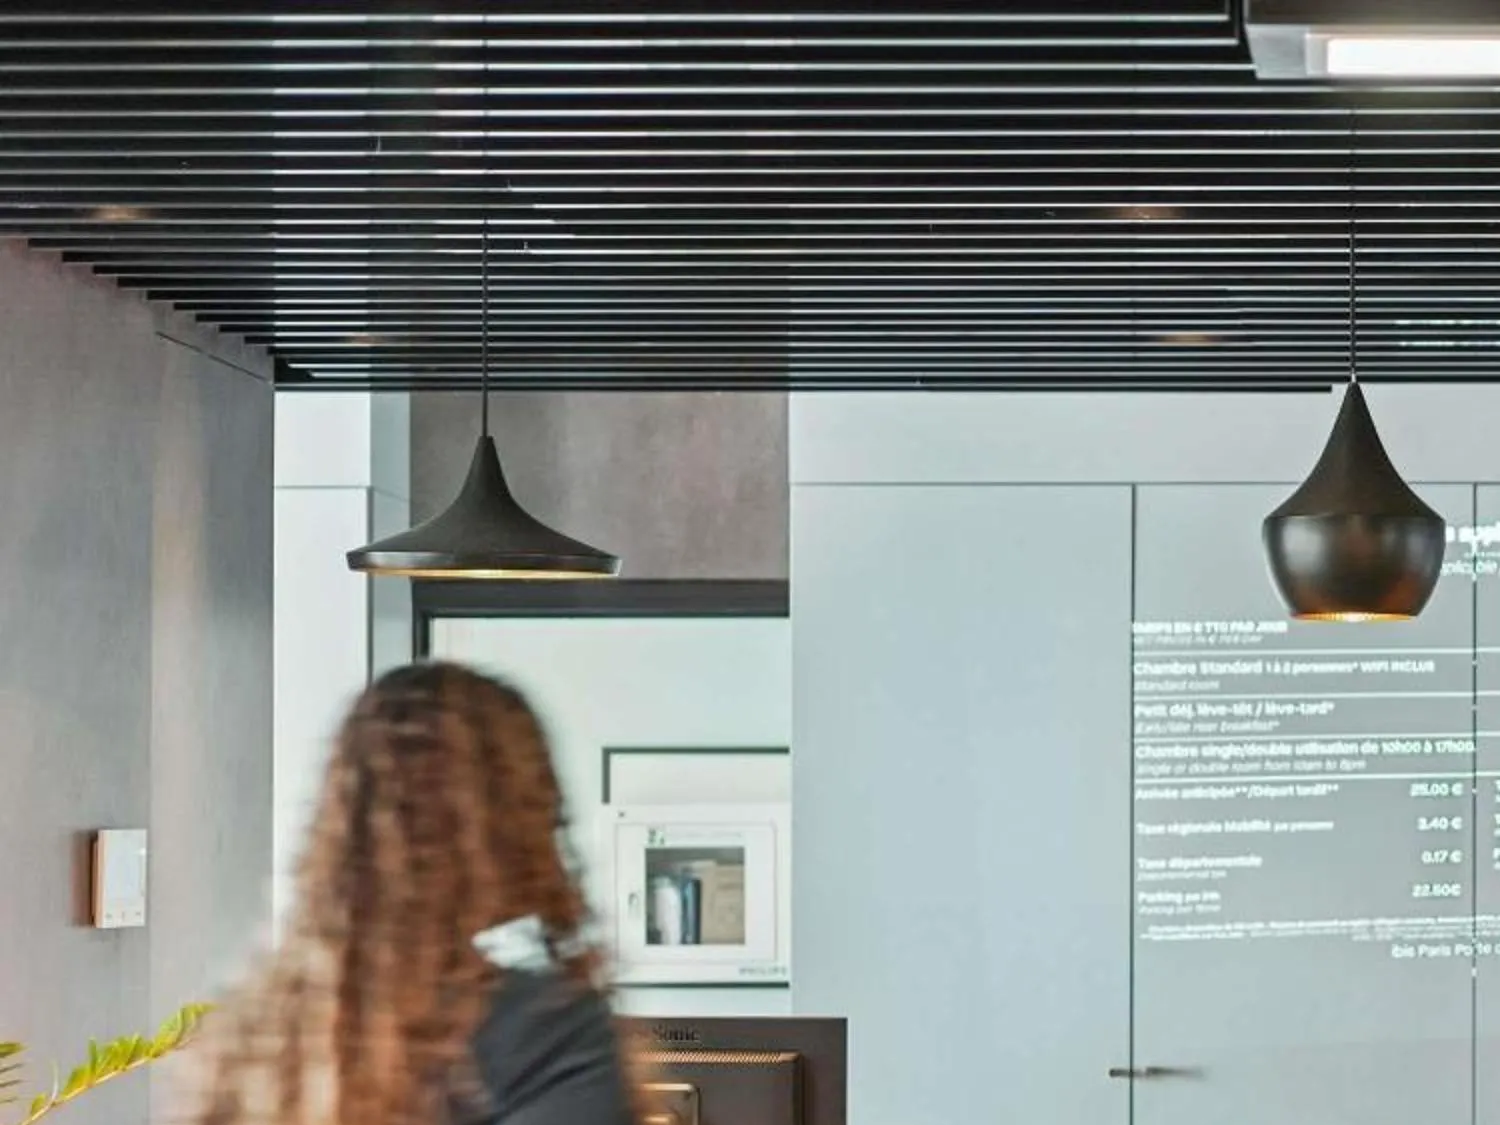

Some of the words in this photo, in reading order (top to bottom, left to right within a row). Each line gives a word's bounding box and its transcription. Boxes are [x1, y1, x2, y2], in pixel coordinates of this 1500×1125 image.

[1134, 661, 1197, 675] Chambre
[1200, 660, 1263, 675] Standard
[1135, 744, 1199, 759] Chambre
[1418, 943, 1452, 957] Paris
[1454, 942, 1493, 957] Pote
